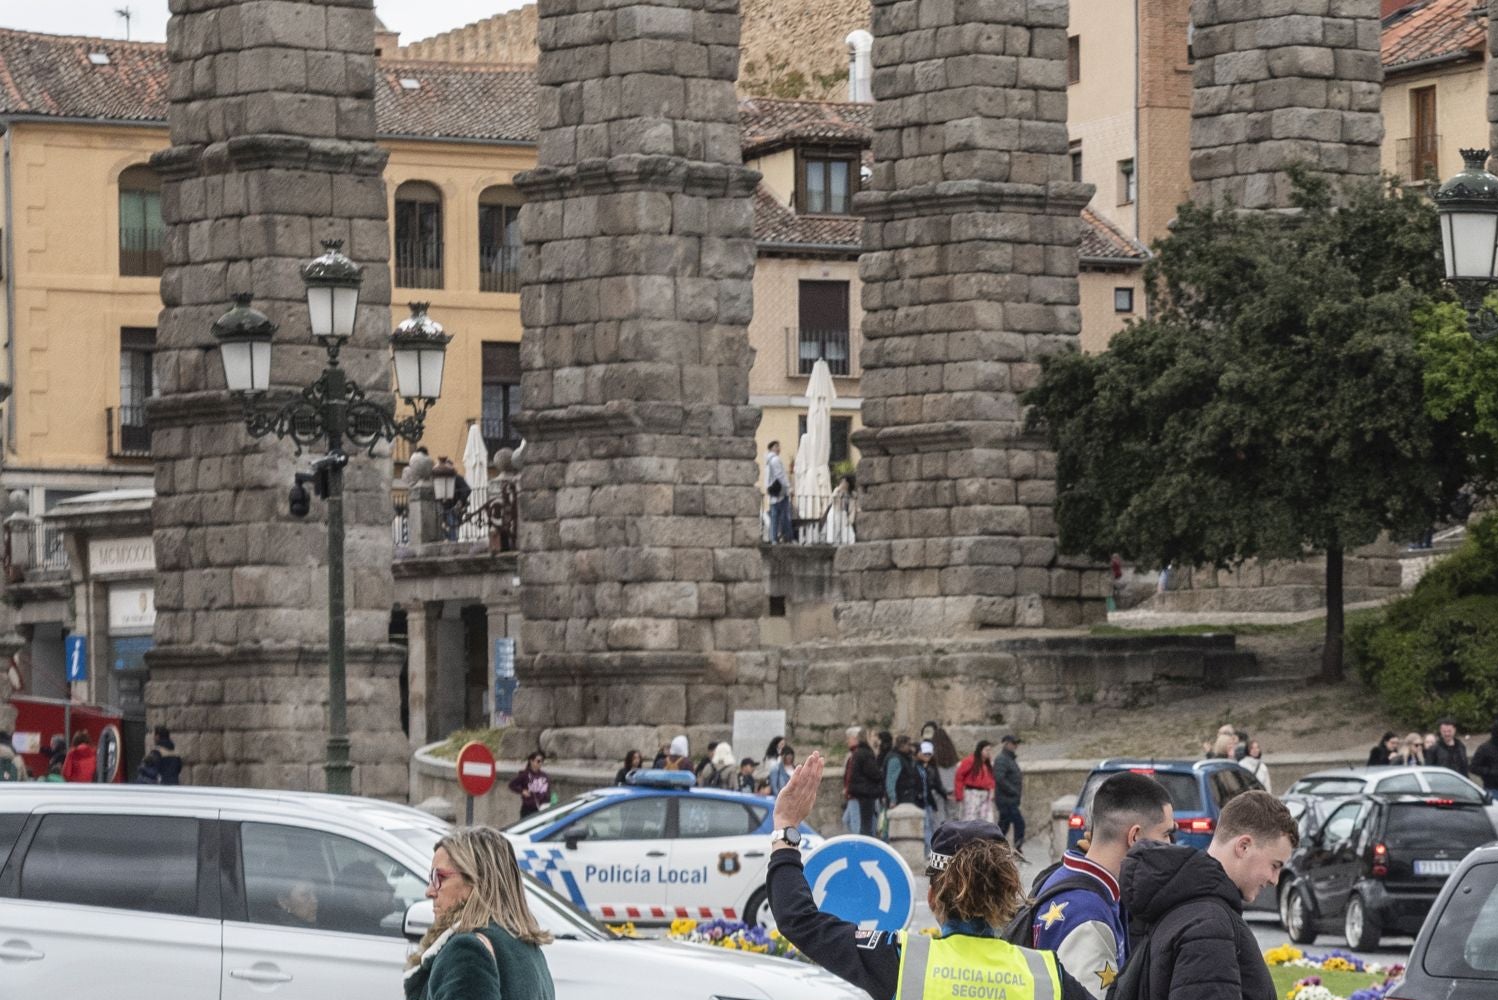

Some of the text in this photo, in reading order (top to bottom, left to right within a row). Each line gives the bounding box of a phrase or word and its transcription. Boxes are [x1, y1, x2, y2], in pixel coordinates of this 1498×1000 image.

[585, 864, 708, 884] Policía Local
[932, 966, 1026, 987] POLICIA LOCAL
[951, 983, 1007, 1000] SEGOVIA
